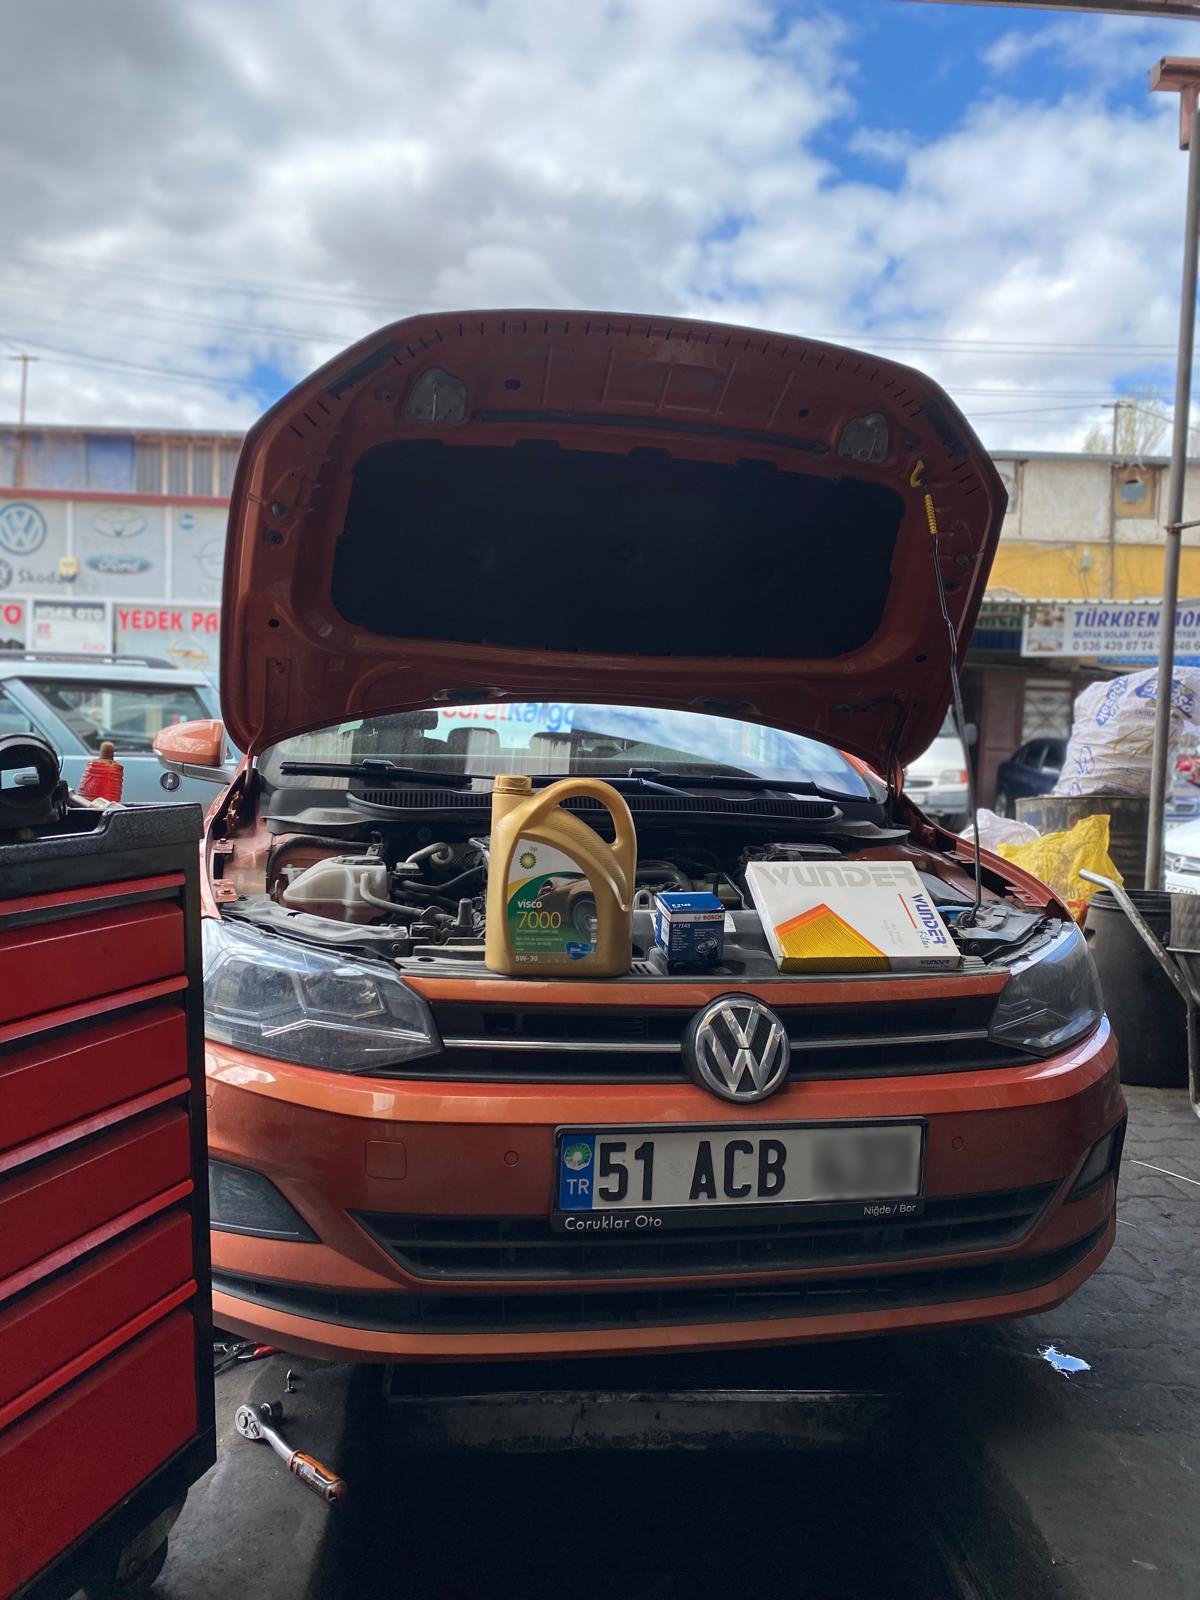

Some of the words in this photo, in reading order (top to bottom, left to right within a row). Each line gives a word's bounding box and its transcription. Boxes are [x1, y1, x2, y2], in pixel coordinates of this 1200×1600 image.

[118, 608, 183, 632] YEDEK
[1074, 608, 1160, 627] TÜRKBEN
[757, 866, 918, 887] WUNDER
[516, 911, 561, 928] 7000
[911, 893, 947, 944] WUNDER
[598, 1142, 655, 1201] 51
[689, 1139, 787, 1200] ACB
[566, 1178, 589, 1196] TR
[863, 1205, 891, 1216] Niğde
[899, 1204, 917, 1213] Bor
[564, 1216, 630, 1230] Coruklar
[635, 1215, 662, 1228] Oto
